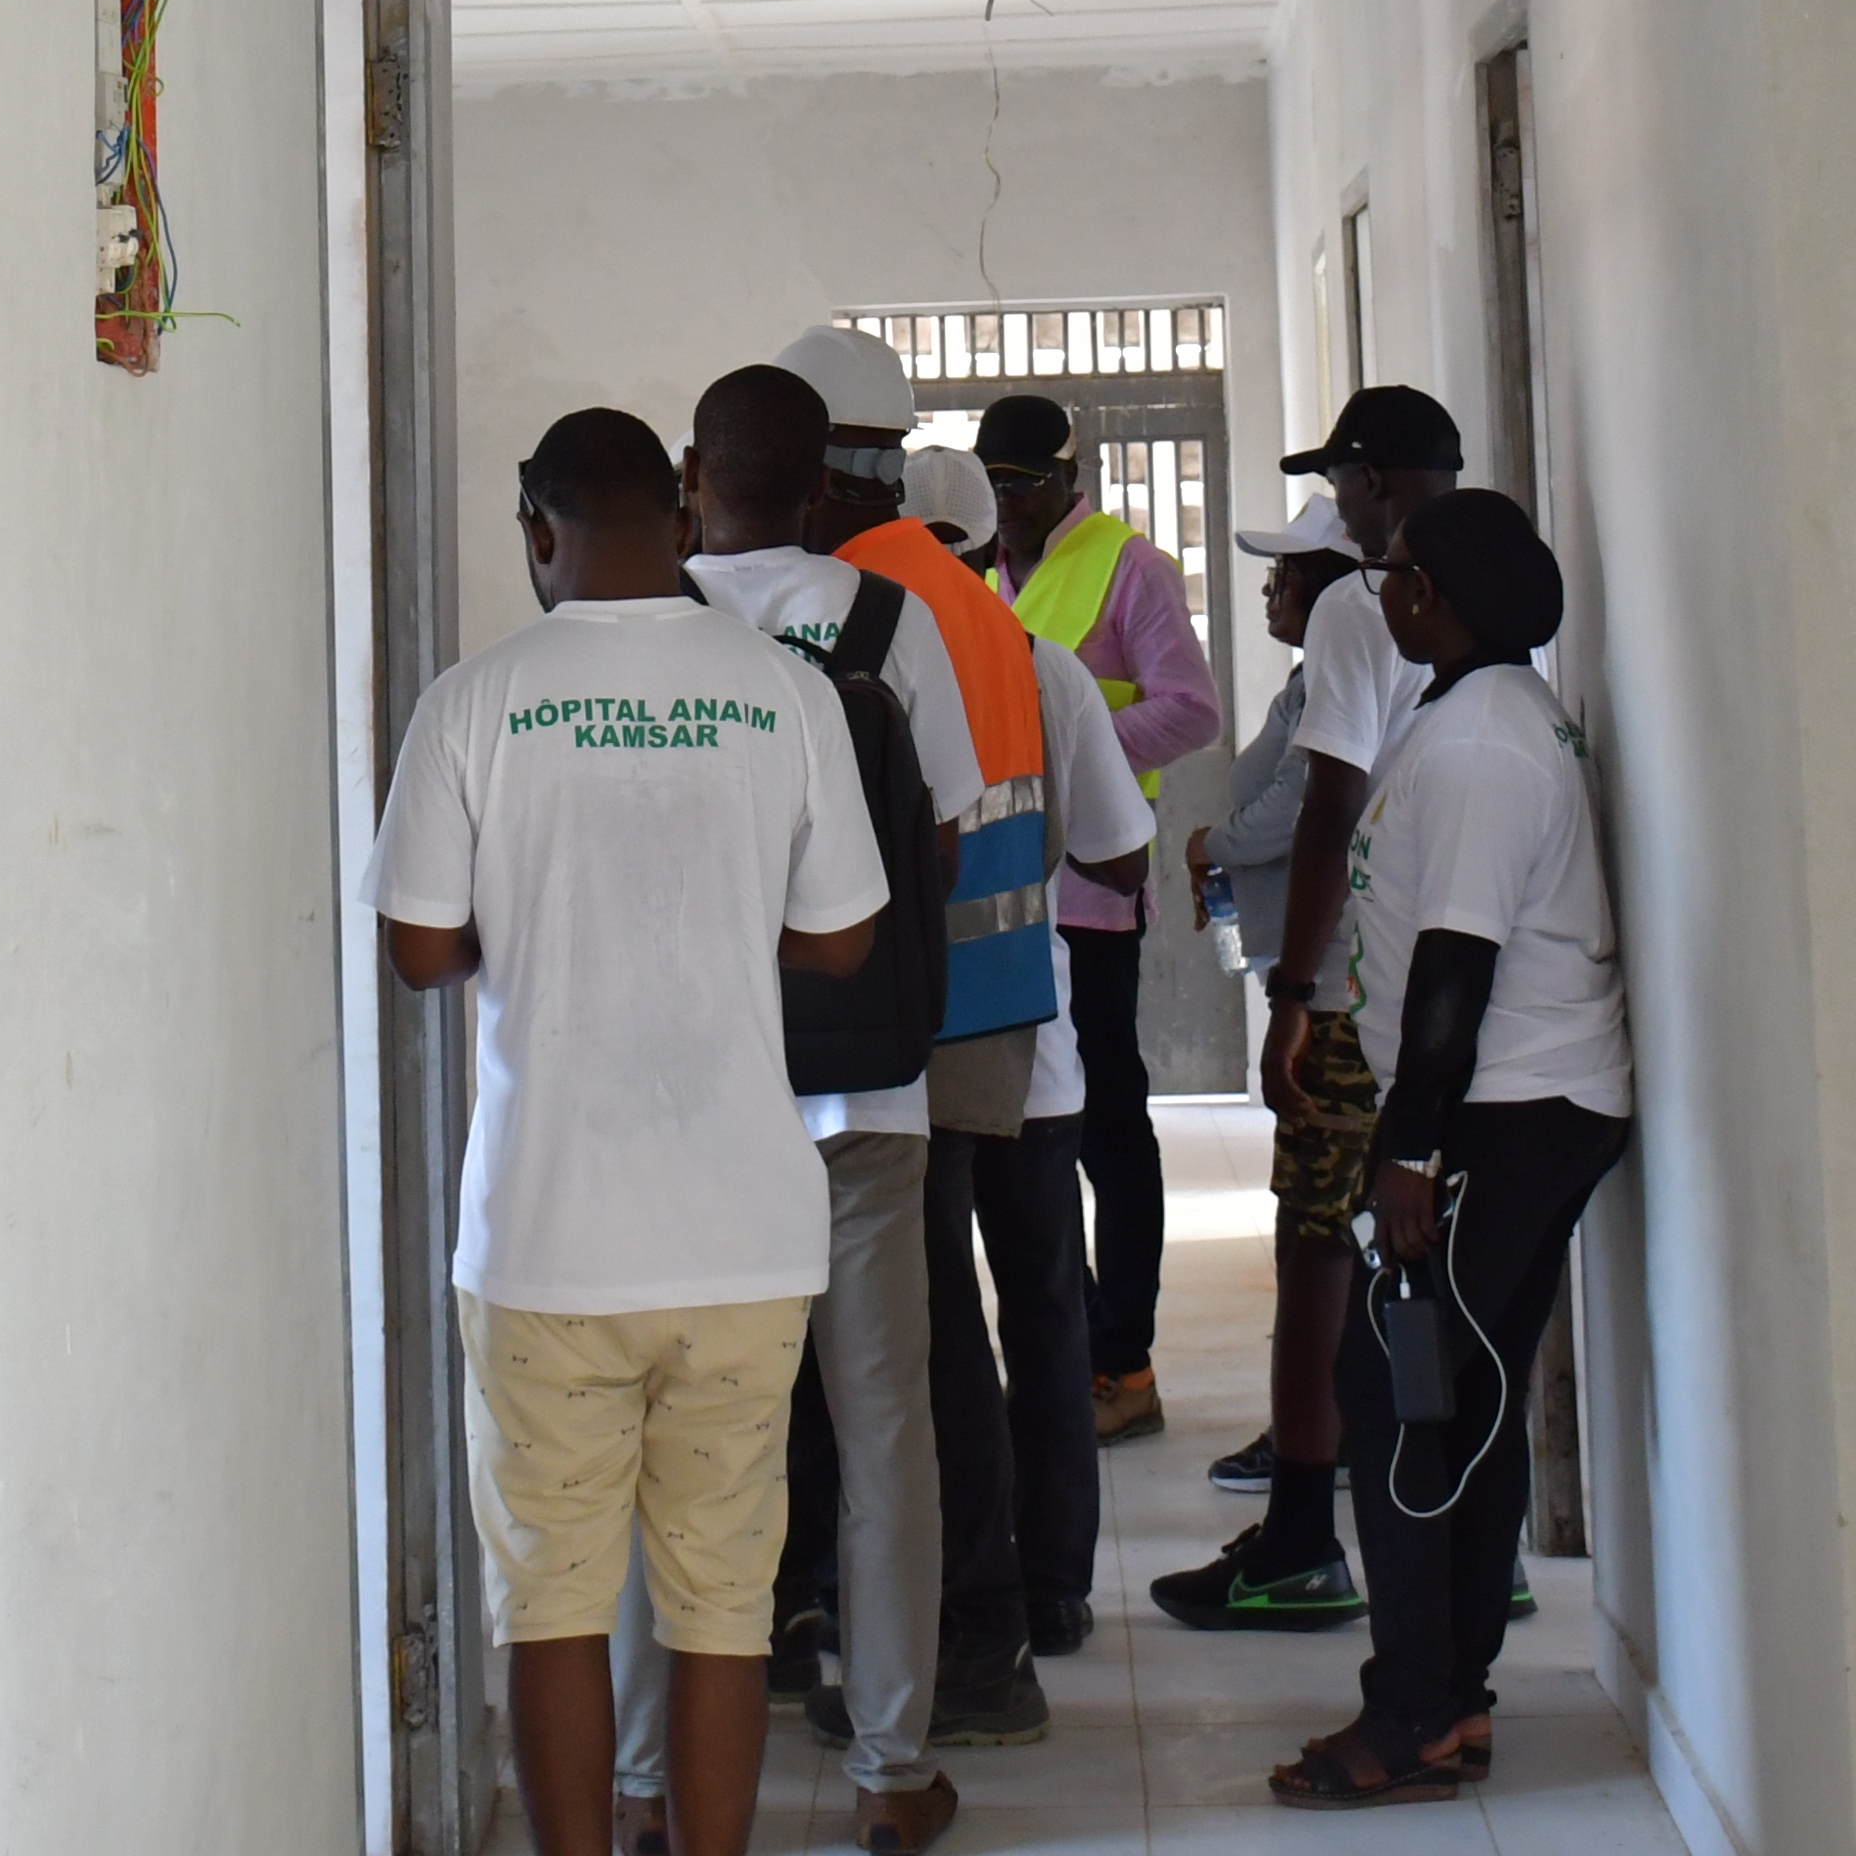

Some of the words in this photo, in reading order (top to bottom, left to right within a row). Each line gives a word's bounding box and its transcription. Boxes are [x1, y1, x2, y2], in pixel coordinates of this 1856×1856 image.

[508, 698, 656, 735] HÔPITAL
[667, 698, 776, 733] ANAIM
[574, 724, 719, 748] KAMSAR
